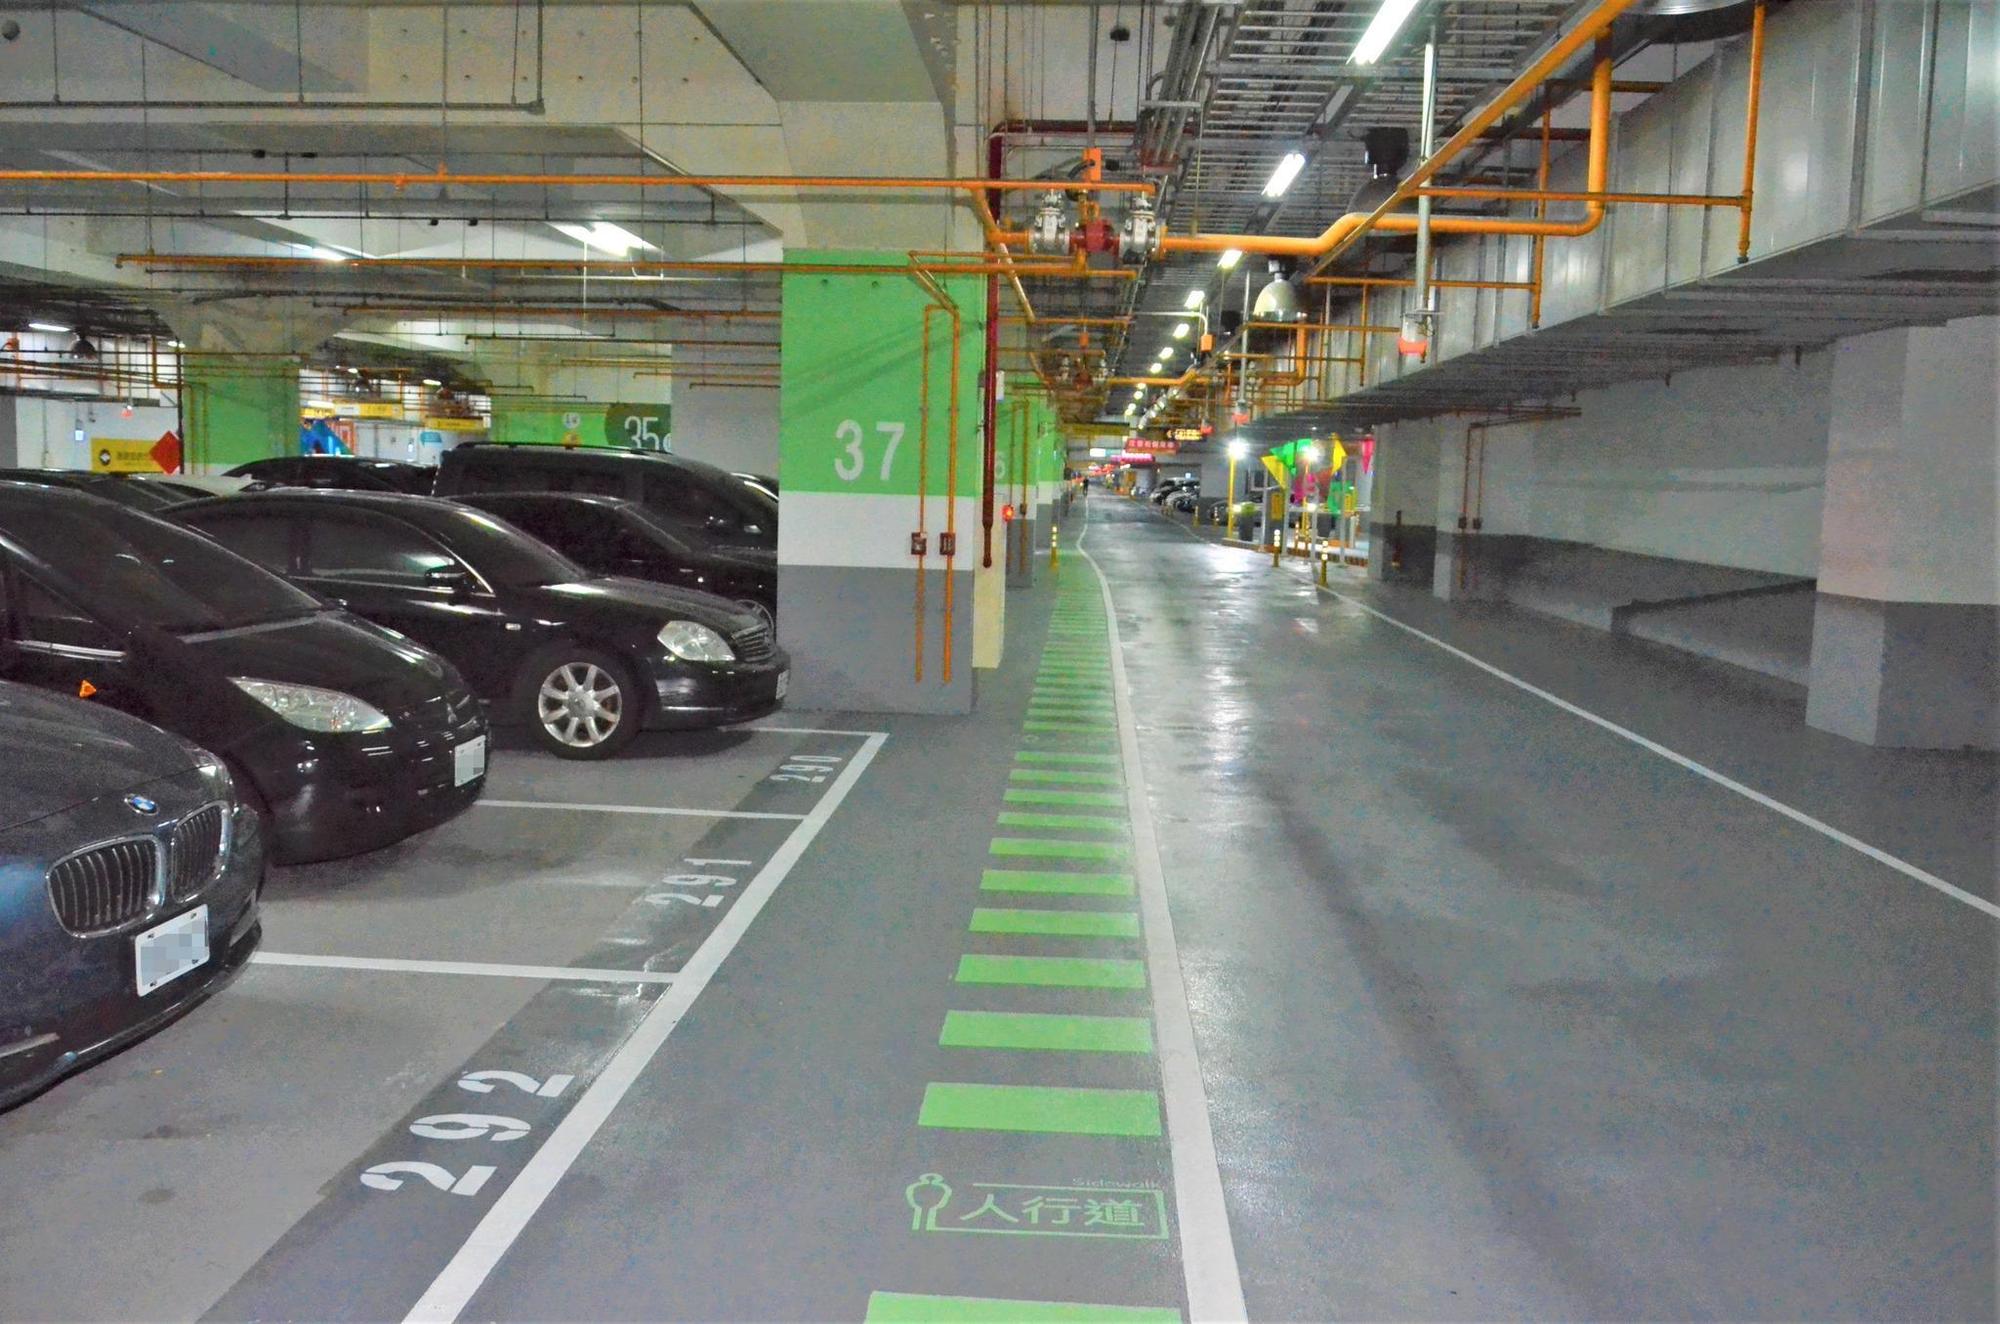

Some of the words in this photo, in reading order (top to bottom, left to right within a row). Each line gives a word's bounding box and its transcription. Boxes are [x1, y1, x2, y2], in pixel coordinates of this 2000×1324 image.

[834, 419, 905, 481] 37
[769, 754, 843, 783] 290
[641, 857, 753, 908] 291
[359, 1070, 576, 1196] 292
[960, 1193, 1145, 1227] 人行道
